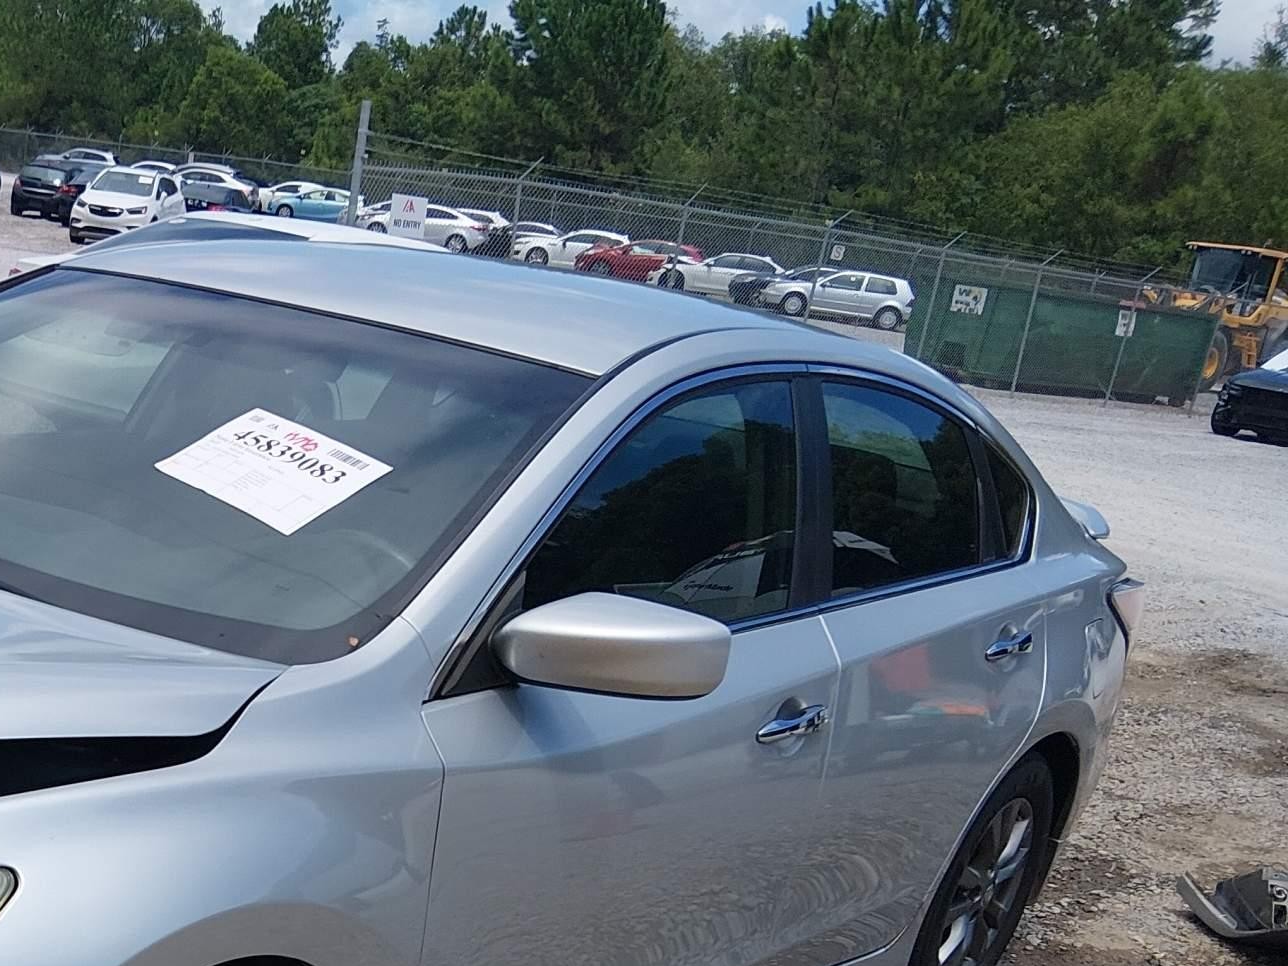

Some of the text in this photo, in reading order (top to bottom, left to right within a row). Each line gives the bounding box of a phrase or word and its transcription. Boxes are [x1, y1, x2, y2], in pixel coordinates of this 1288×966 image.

[393, 219, 421, 230] NO ENTRY
[233, 430, 347, 485] 45839083
